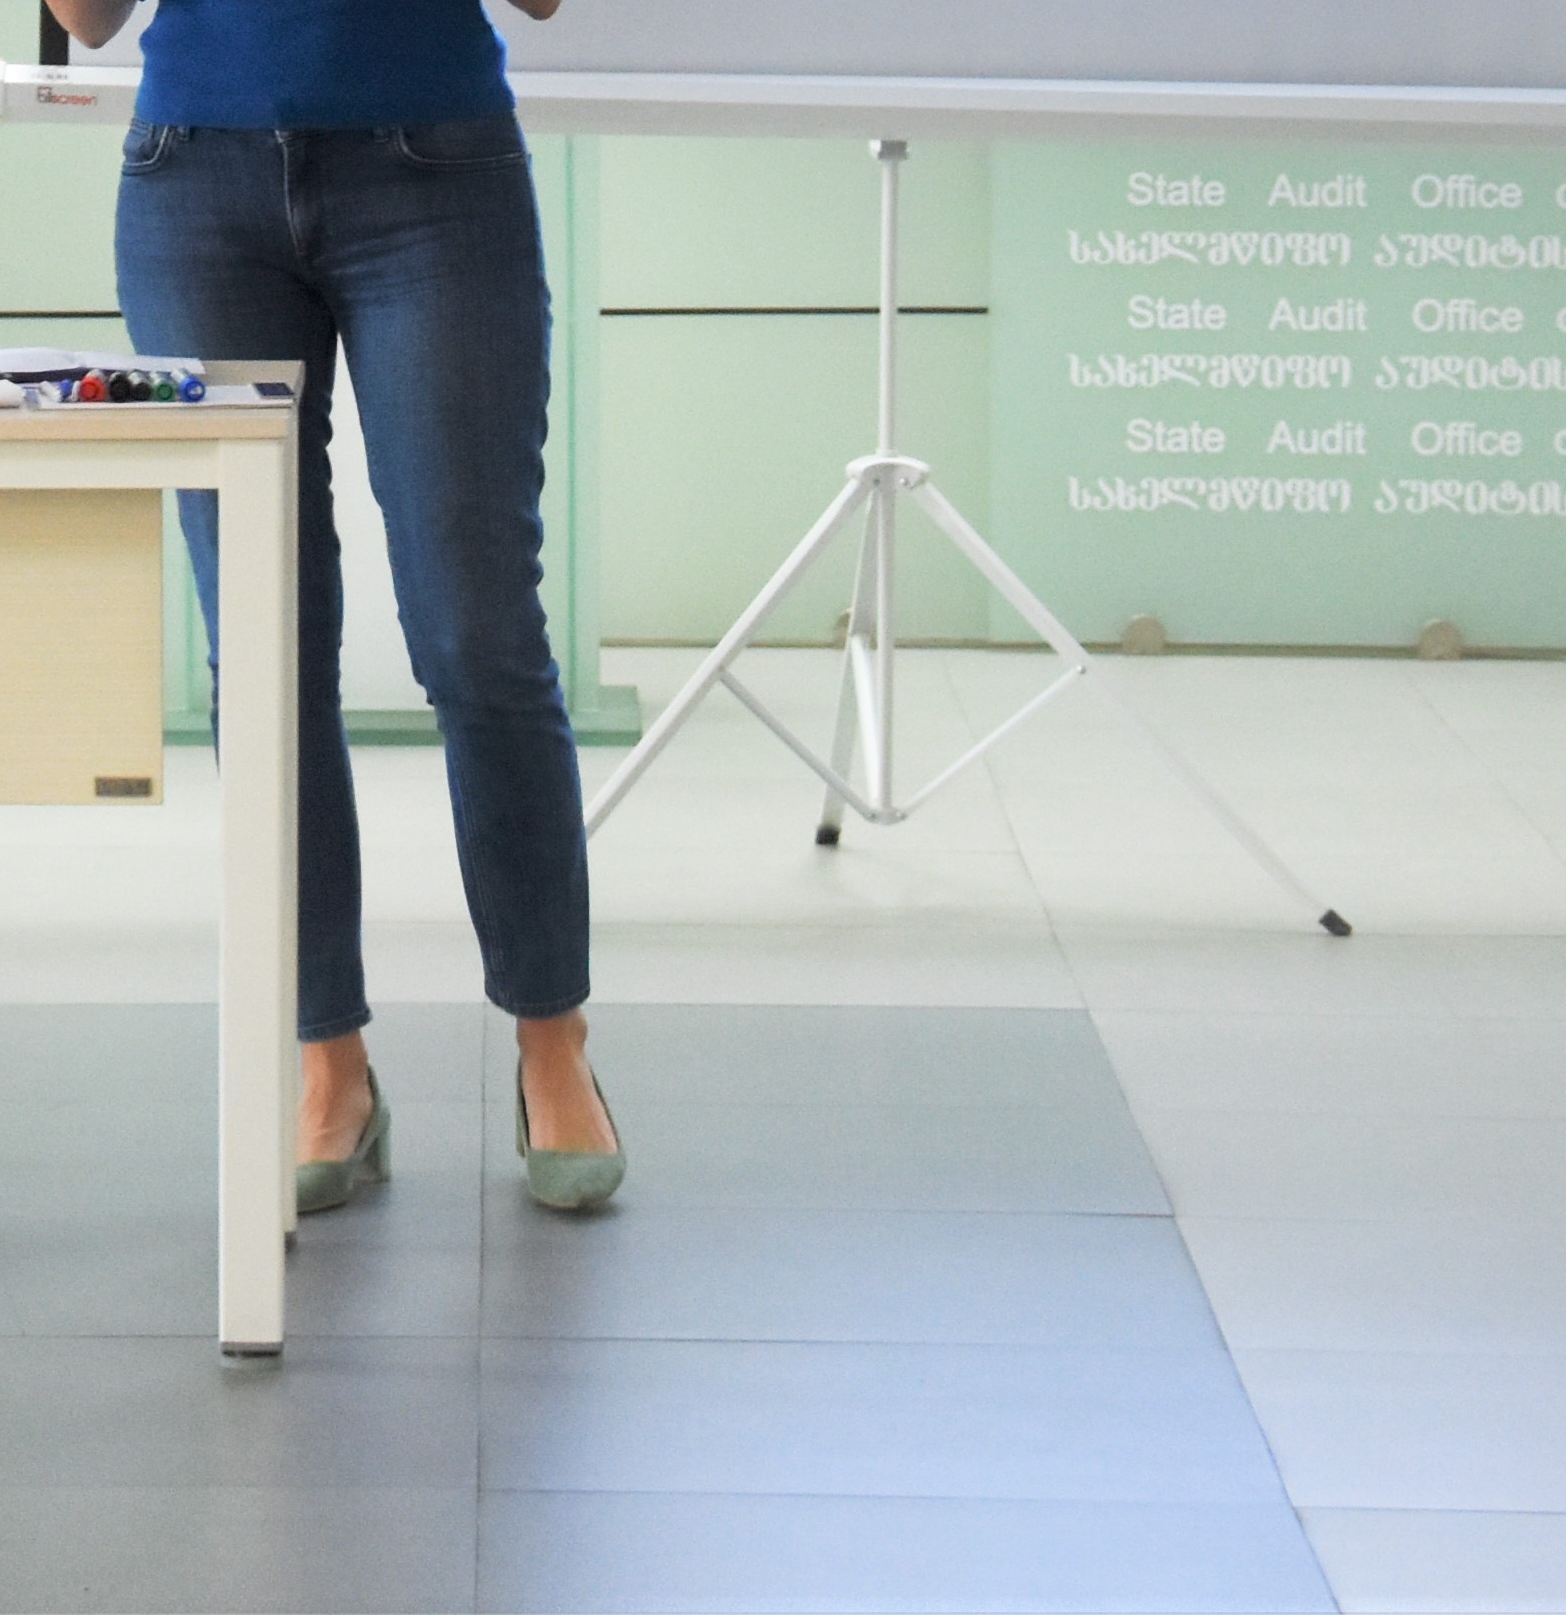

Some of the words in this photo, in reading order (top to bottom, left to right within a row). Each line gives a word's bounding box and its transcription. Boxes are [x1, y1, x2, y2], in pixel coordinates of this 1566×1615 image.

[1126, 172, 1227, 208] State
[1268, 174, 1368, 210] Audit
[1412, 174, 1523, 210] Office
[1126, 297, 1227, 333] State
[1268, 298, 1368, 334] Audit
[1412, 299, 1523, 335] Office
[1126, 419, 1227, 455] State
[1268, 421, 1368, 457] Audit
[1412, 421, 1523, 457] Office
